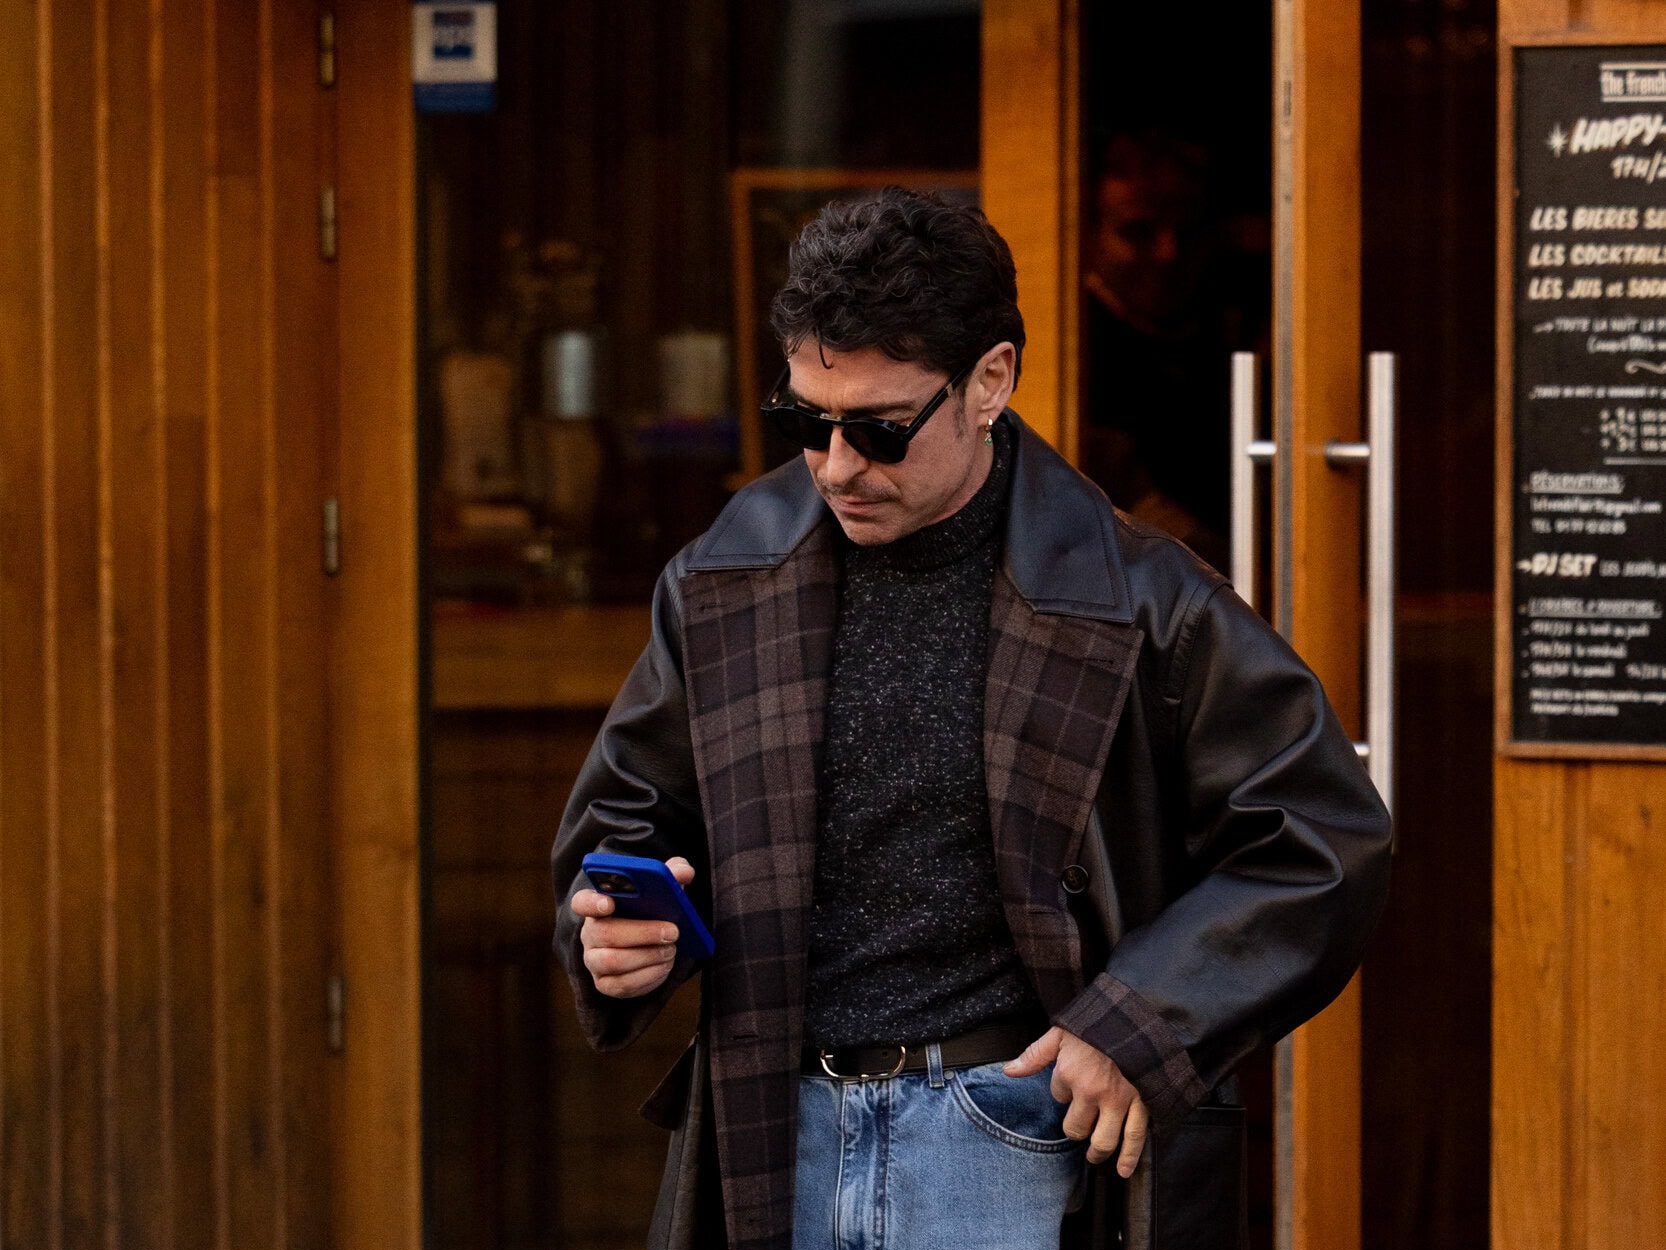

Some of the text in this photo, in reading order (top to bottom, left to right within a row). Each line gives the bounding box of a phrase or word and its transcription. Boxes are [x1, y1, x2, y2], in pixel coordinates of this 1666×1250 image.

[1530, 206, 1568, 231] LES
[1572, 206, 1639, 231] BIERES
[1528, 243, 1666, 267] LES COCKTAIL
[1528, 277, 1563, 300] LES
[1567, 277, 1603, 299] JUS
[1531, 552, 1558, 576] DJ
[1558, 552, 1597, 577] SET
